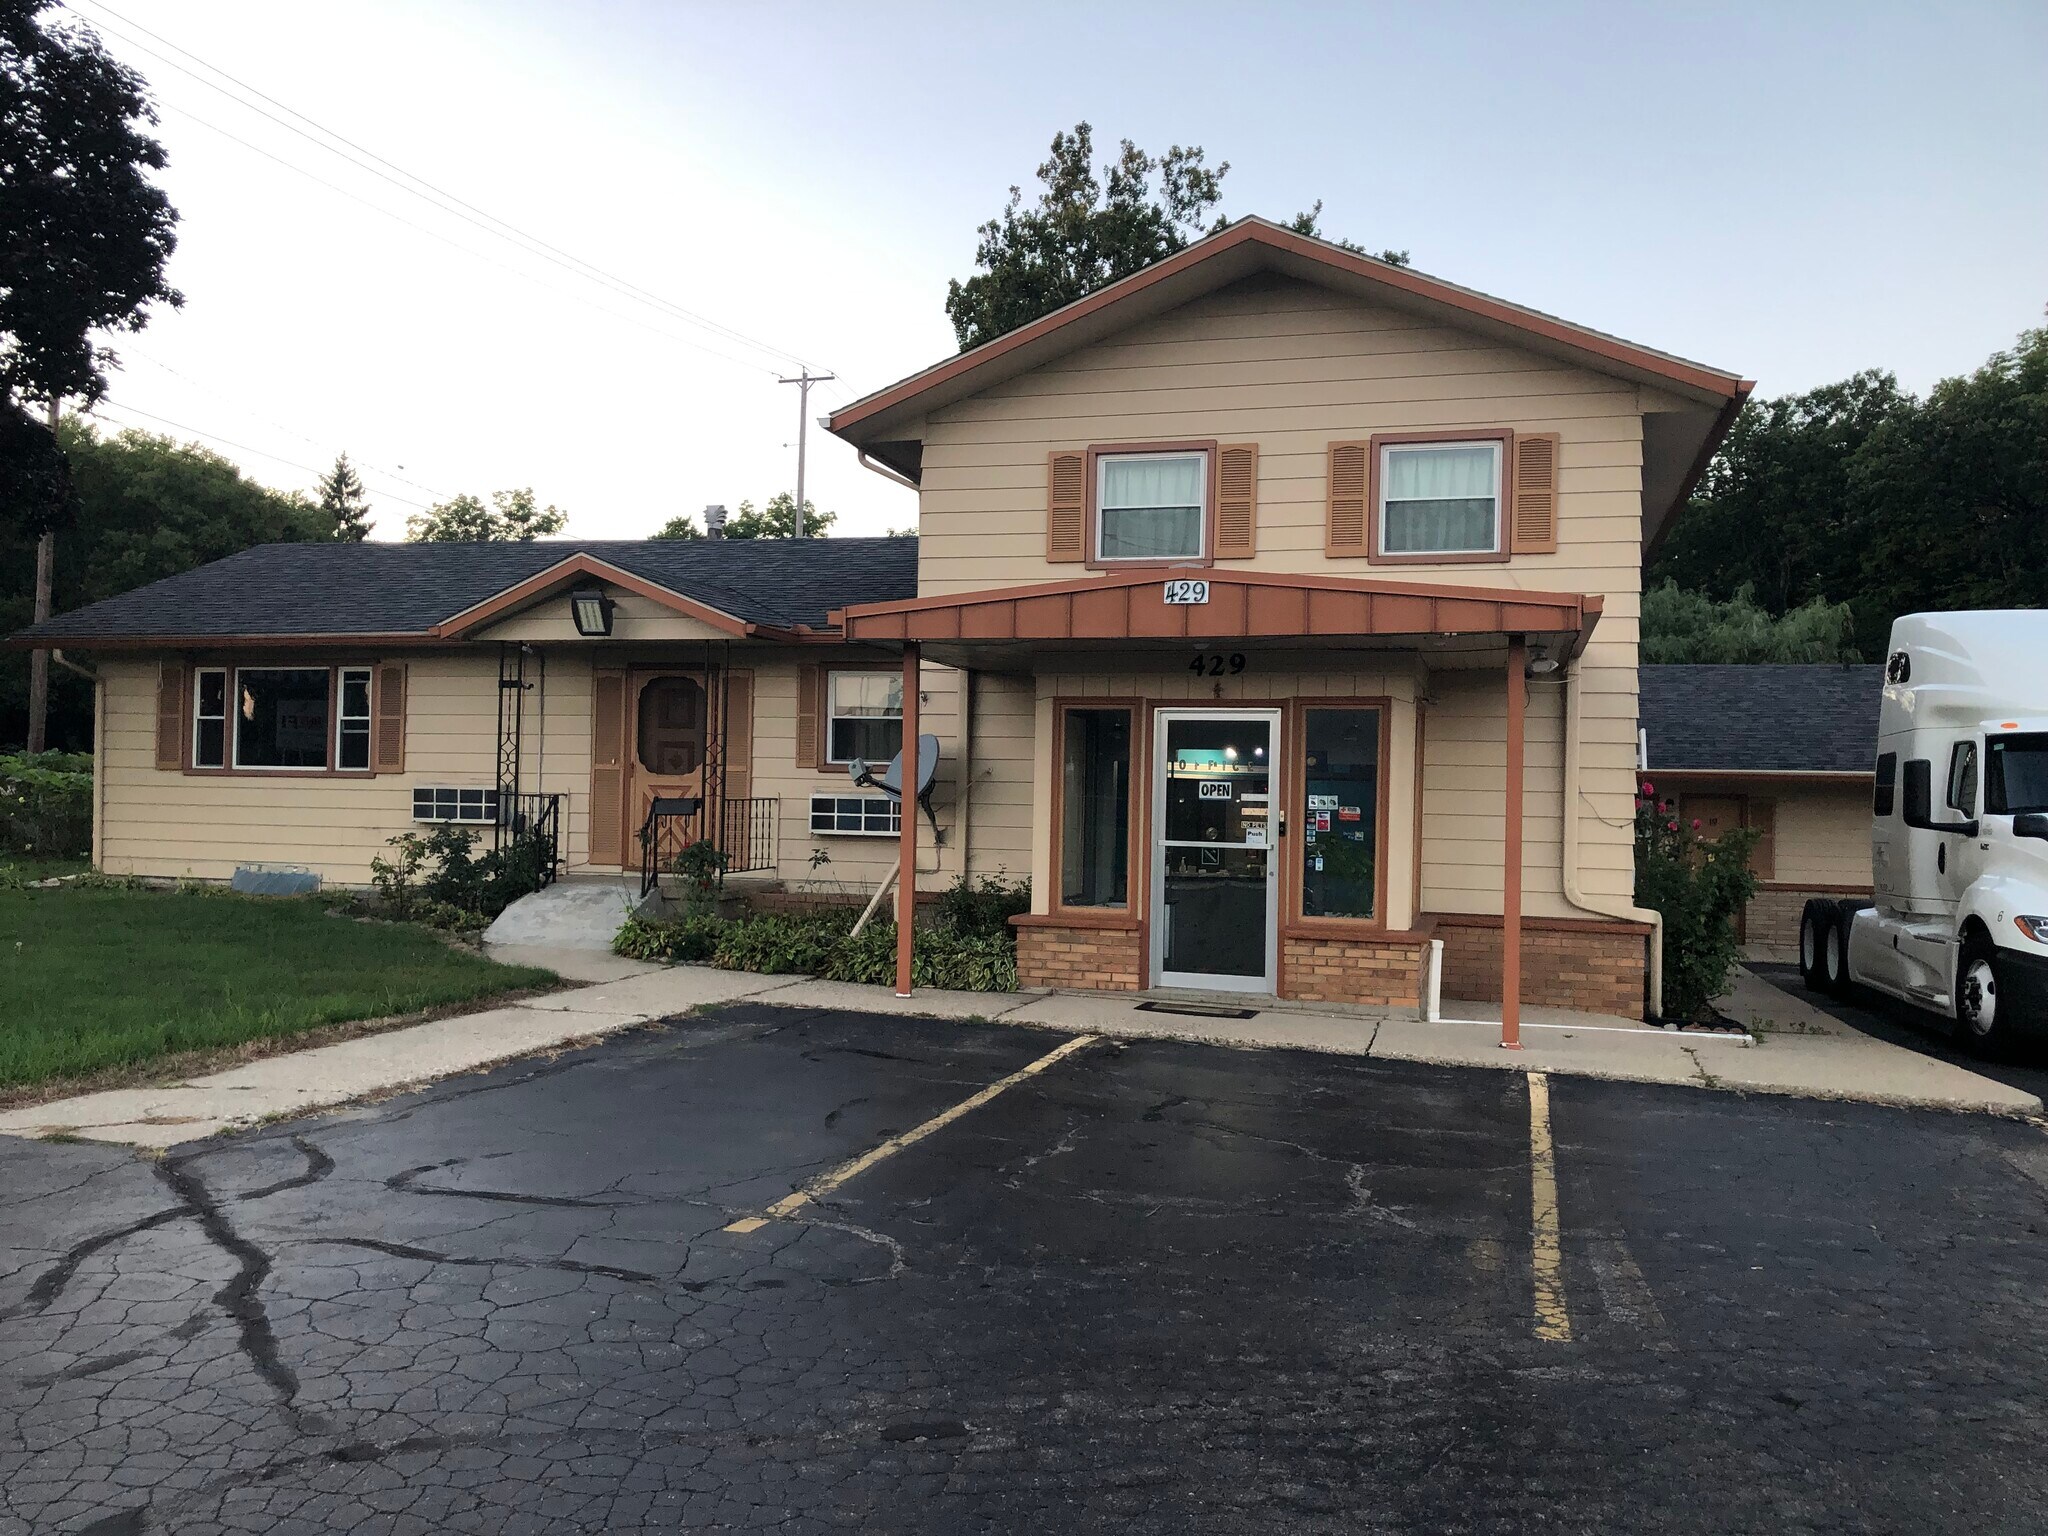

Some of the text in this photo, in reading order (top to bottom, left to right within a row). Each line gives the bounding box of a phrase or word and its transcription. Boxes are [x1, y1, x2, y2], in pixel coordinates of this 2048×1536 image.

[1165, 582, 1205, 602] 429
[1189, 653, 1246, 676] 429
[1201, 784, 1230, 797] OPEN
